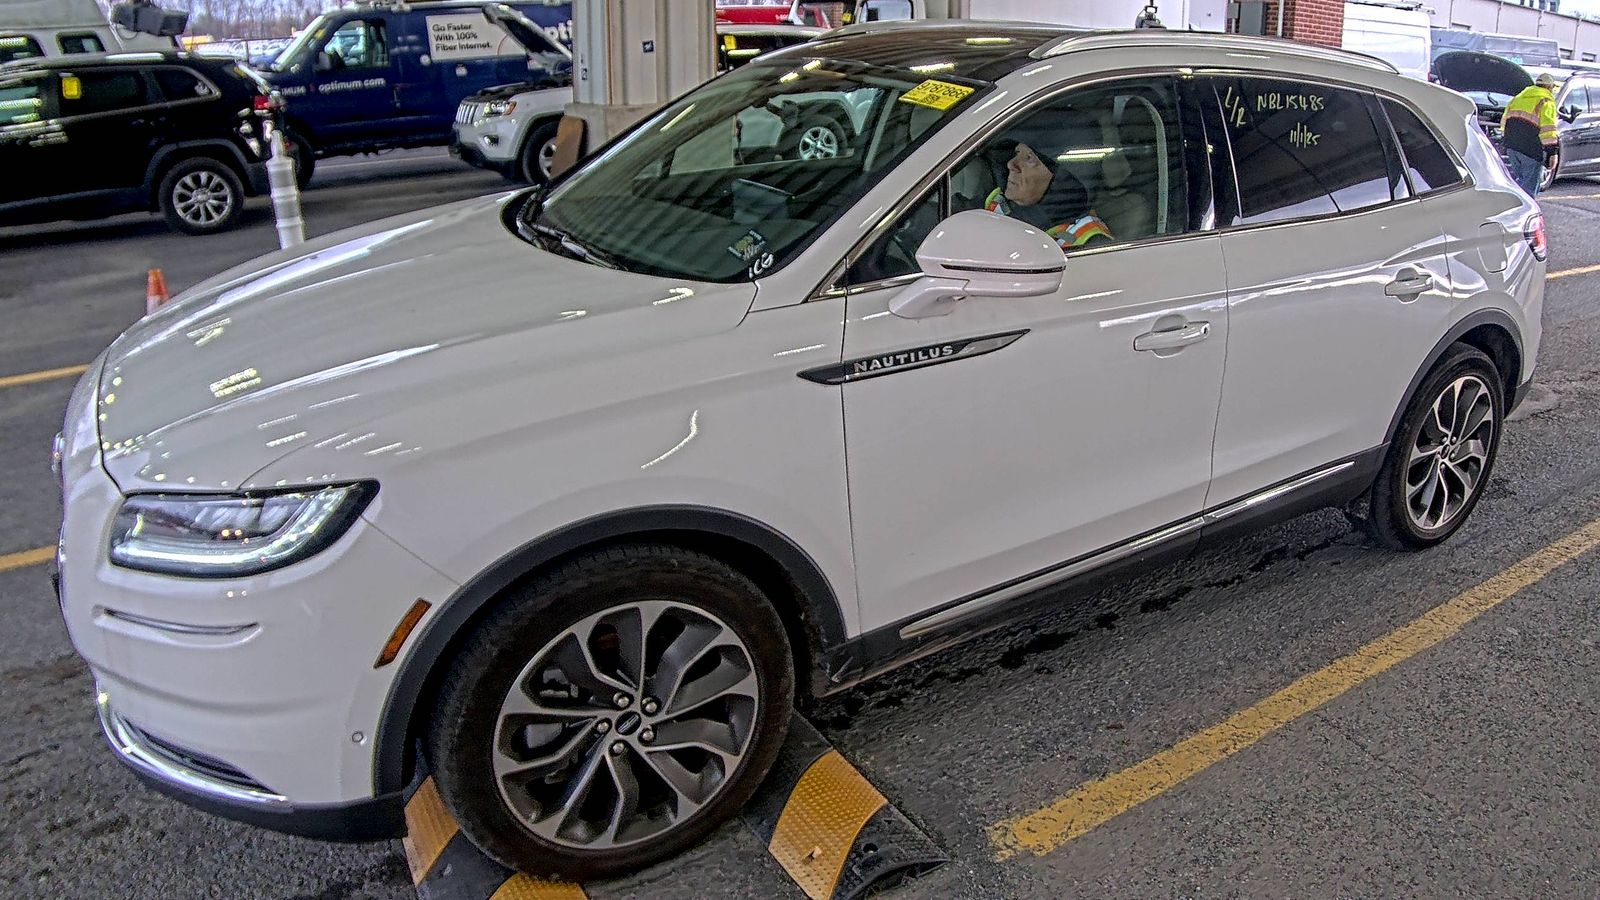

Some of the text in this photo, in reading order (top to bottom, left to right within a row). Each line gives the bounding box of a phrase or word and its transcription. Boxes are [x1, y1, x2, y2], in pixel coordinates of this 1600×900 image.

[432, 23, 472, 32] Go Faster
[434, 32, 478, 42] With 100%
[435, 42, 457, 51] Fiber
[458, 41, 493, 50] Internet.
[318, 77, 386, 94] optimum.com
[1290, 122, 1321, 149] 11/1/25
[853, 345, 953, 374] NAUTILUS
